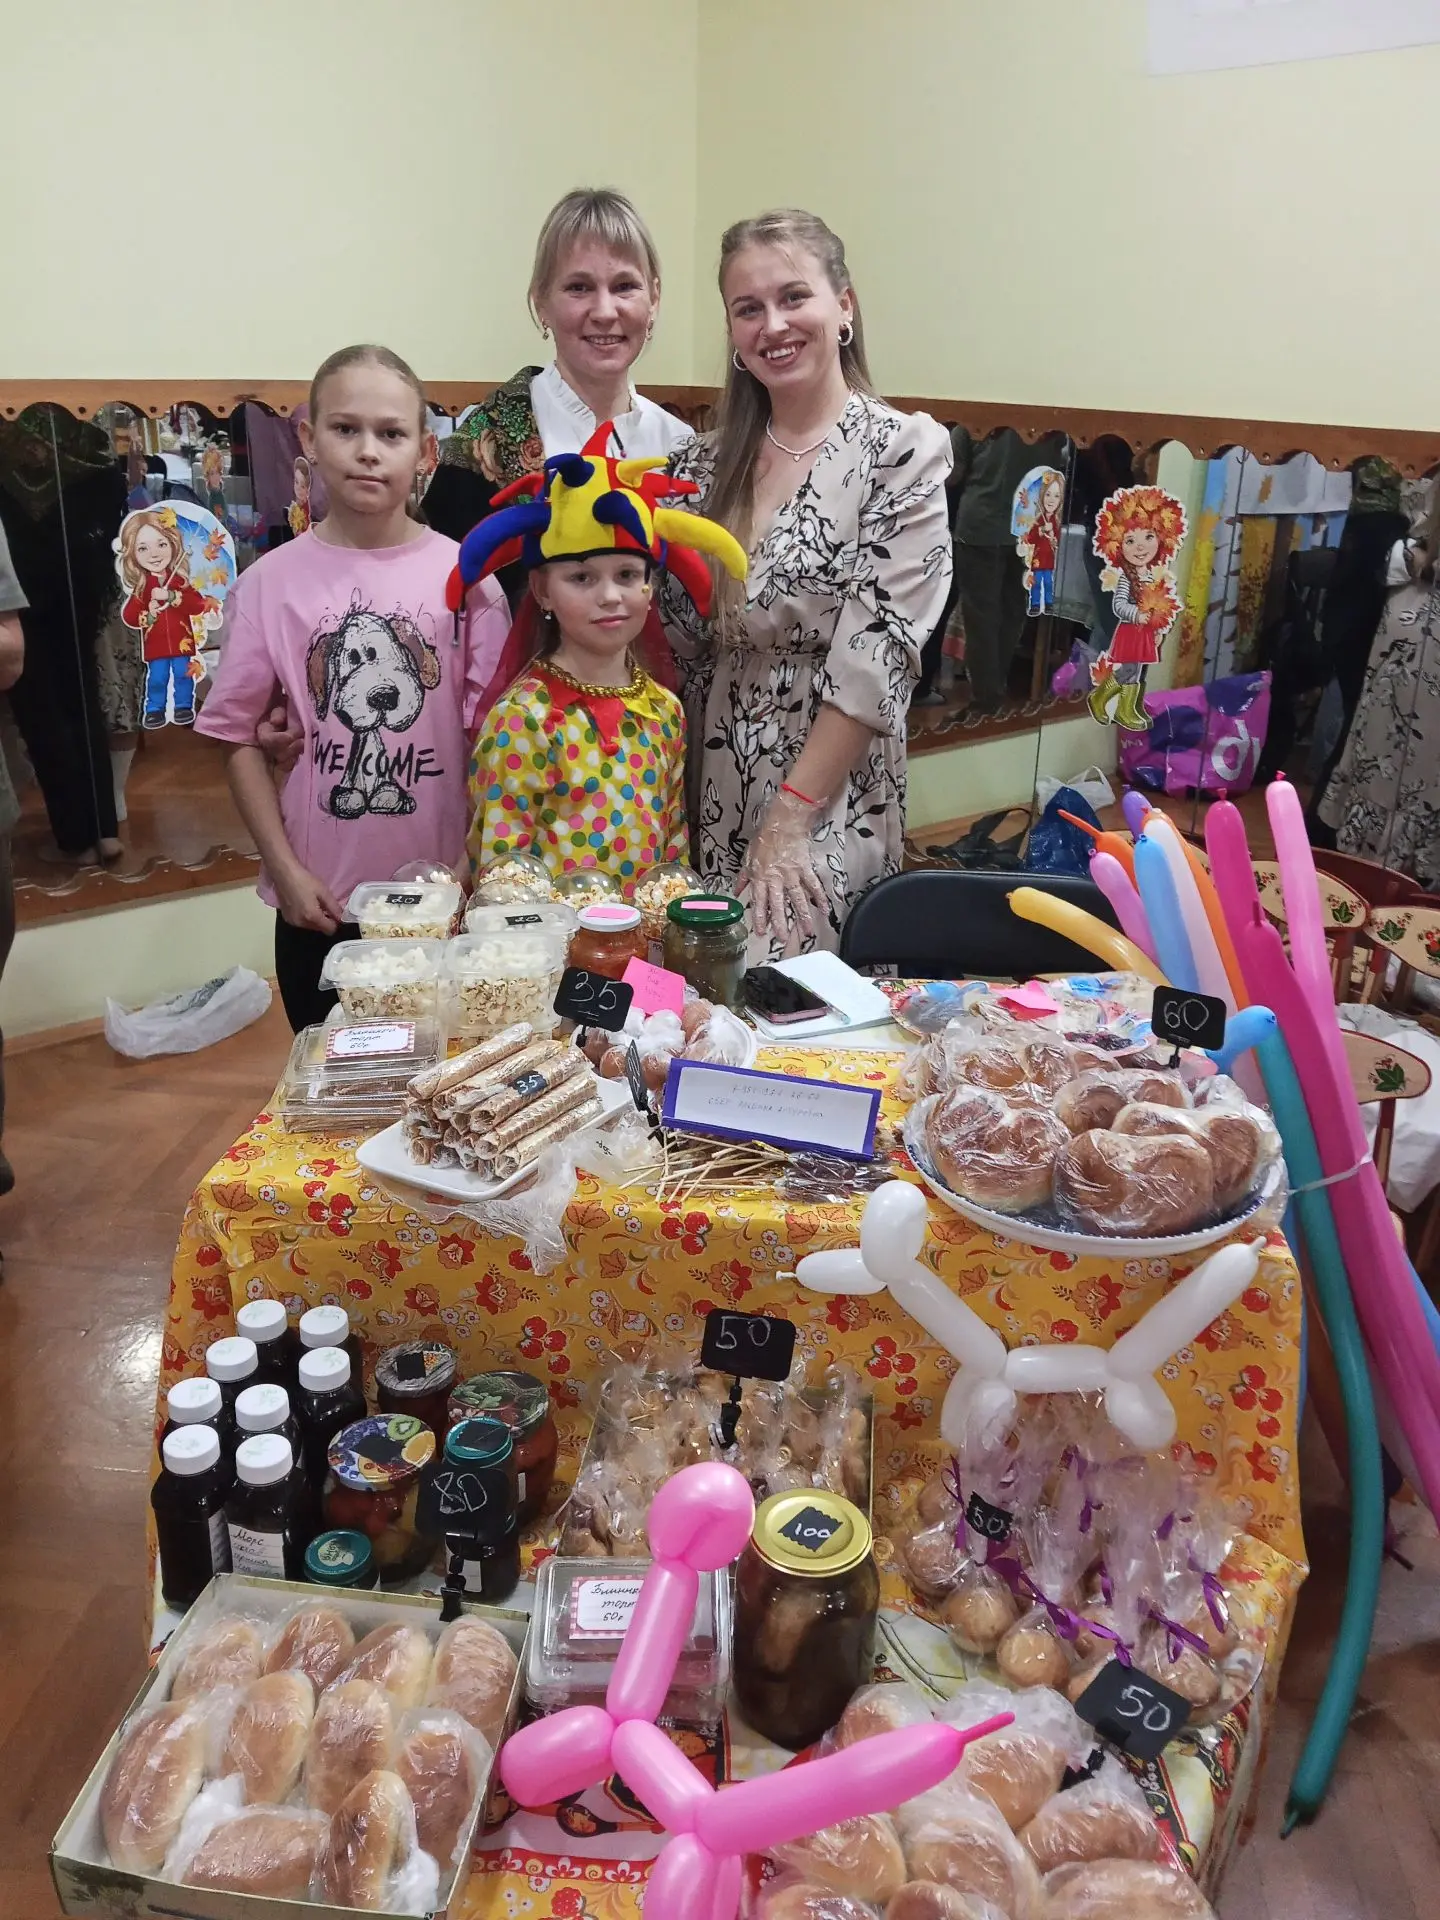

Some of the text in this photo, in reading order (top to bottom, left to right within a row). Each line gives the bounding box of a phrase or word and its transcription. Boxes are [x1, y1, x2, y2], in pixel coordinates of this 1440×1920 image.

[569, 971, 617, 1011] 35
[1163, 998, 1210, 1031] 60
[516, 1074, 541, 1094] 35
[715, 1315, 772, 1350] 50
[794, 1522, 831, 1539] 100
[972, 1505, 1005, 1535] 50
[1114, 1684, 1171, 1732] 50
